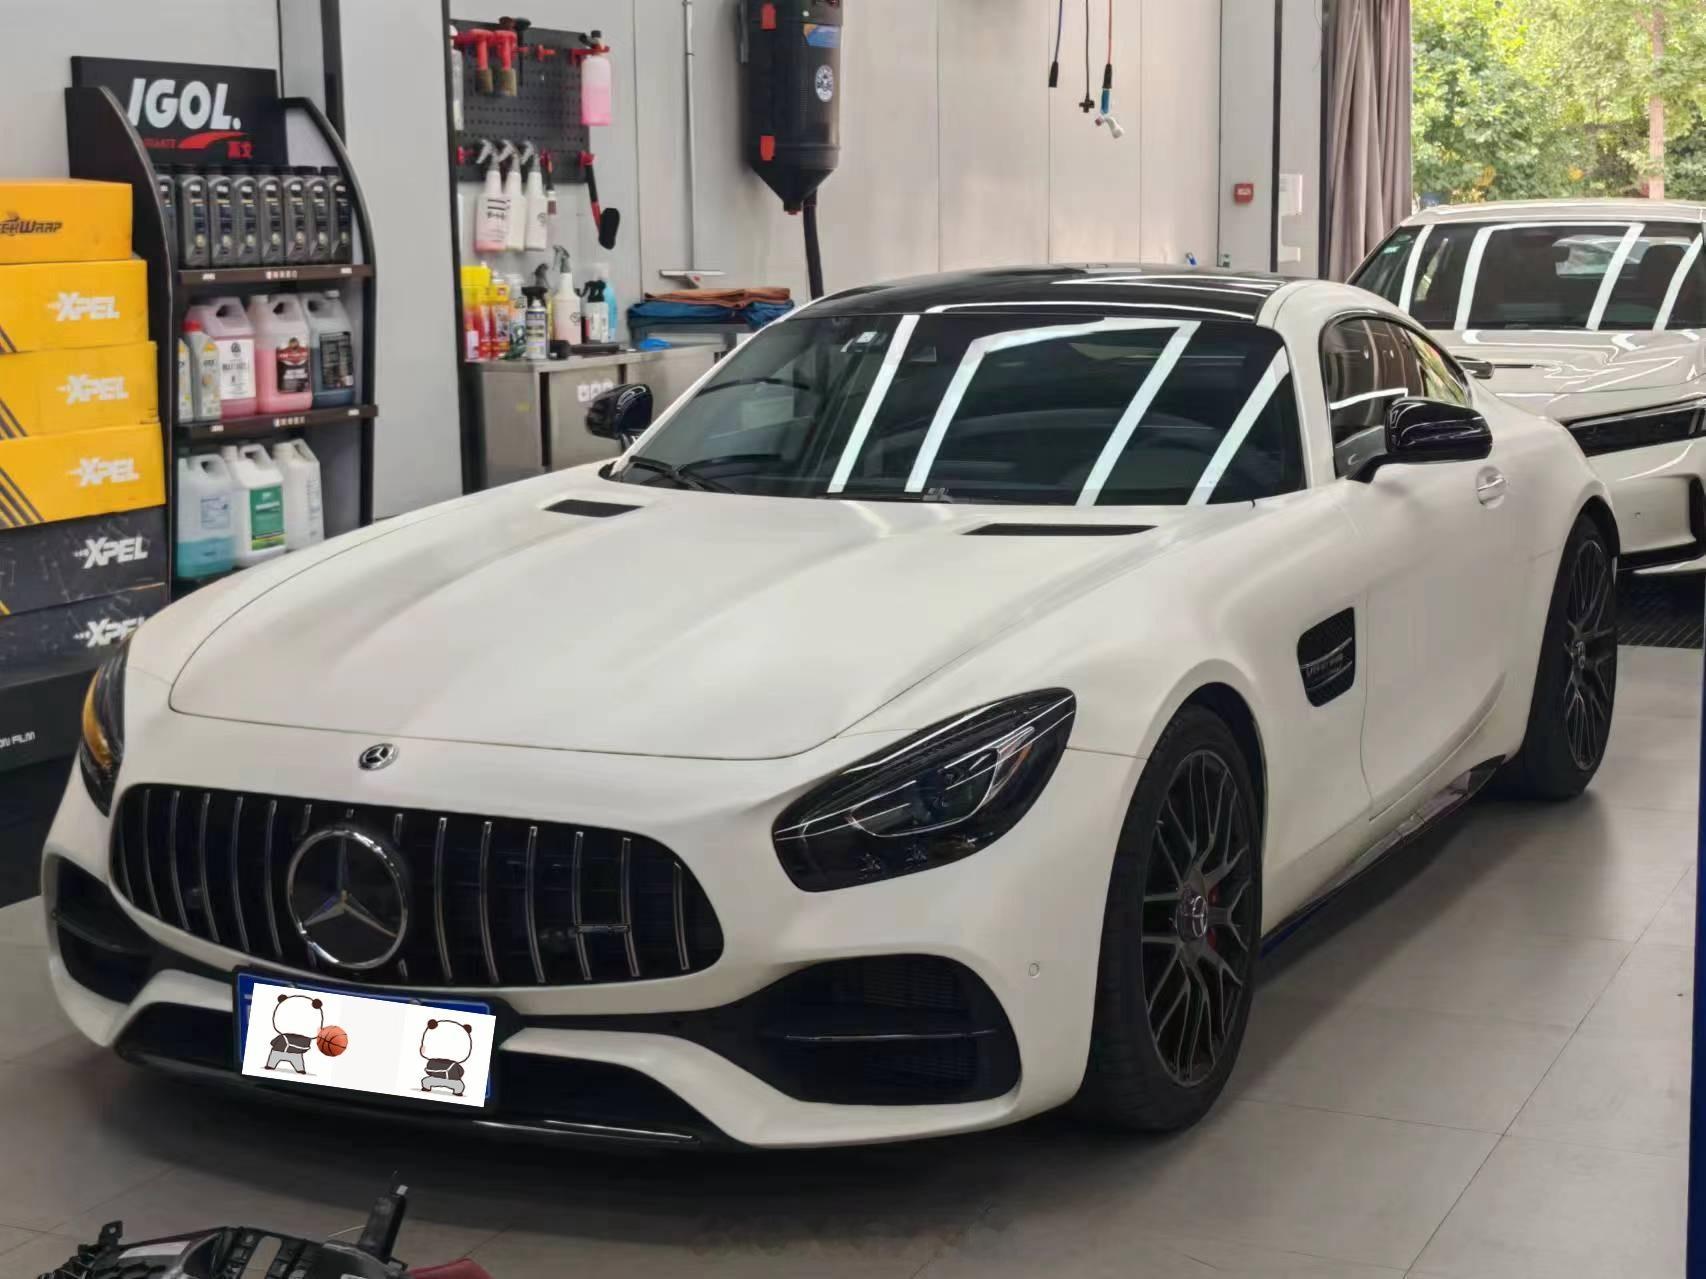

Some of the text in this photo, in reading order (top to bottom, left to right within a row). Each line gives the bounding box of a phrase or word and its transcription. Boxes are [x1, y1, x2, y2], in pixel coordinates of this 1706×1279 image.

[55, 291, 121, 322] XPEL
[65, 374, 129, 406] XPEL
[78, 456, 140, 487] XPEL
[82, 536, 149, 569] XPEL
[86, 616, 145, 648] XPE
